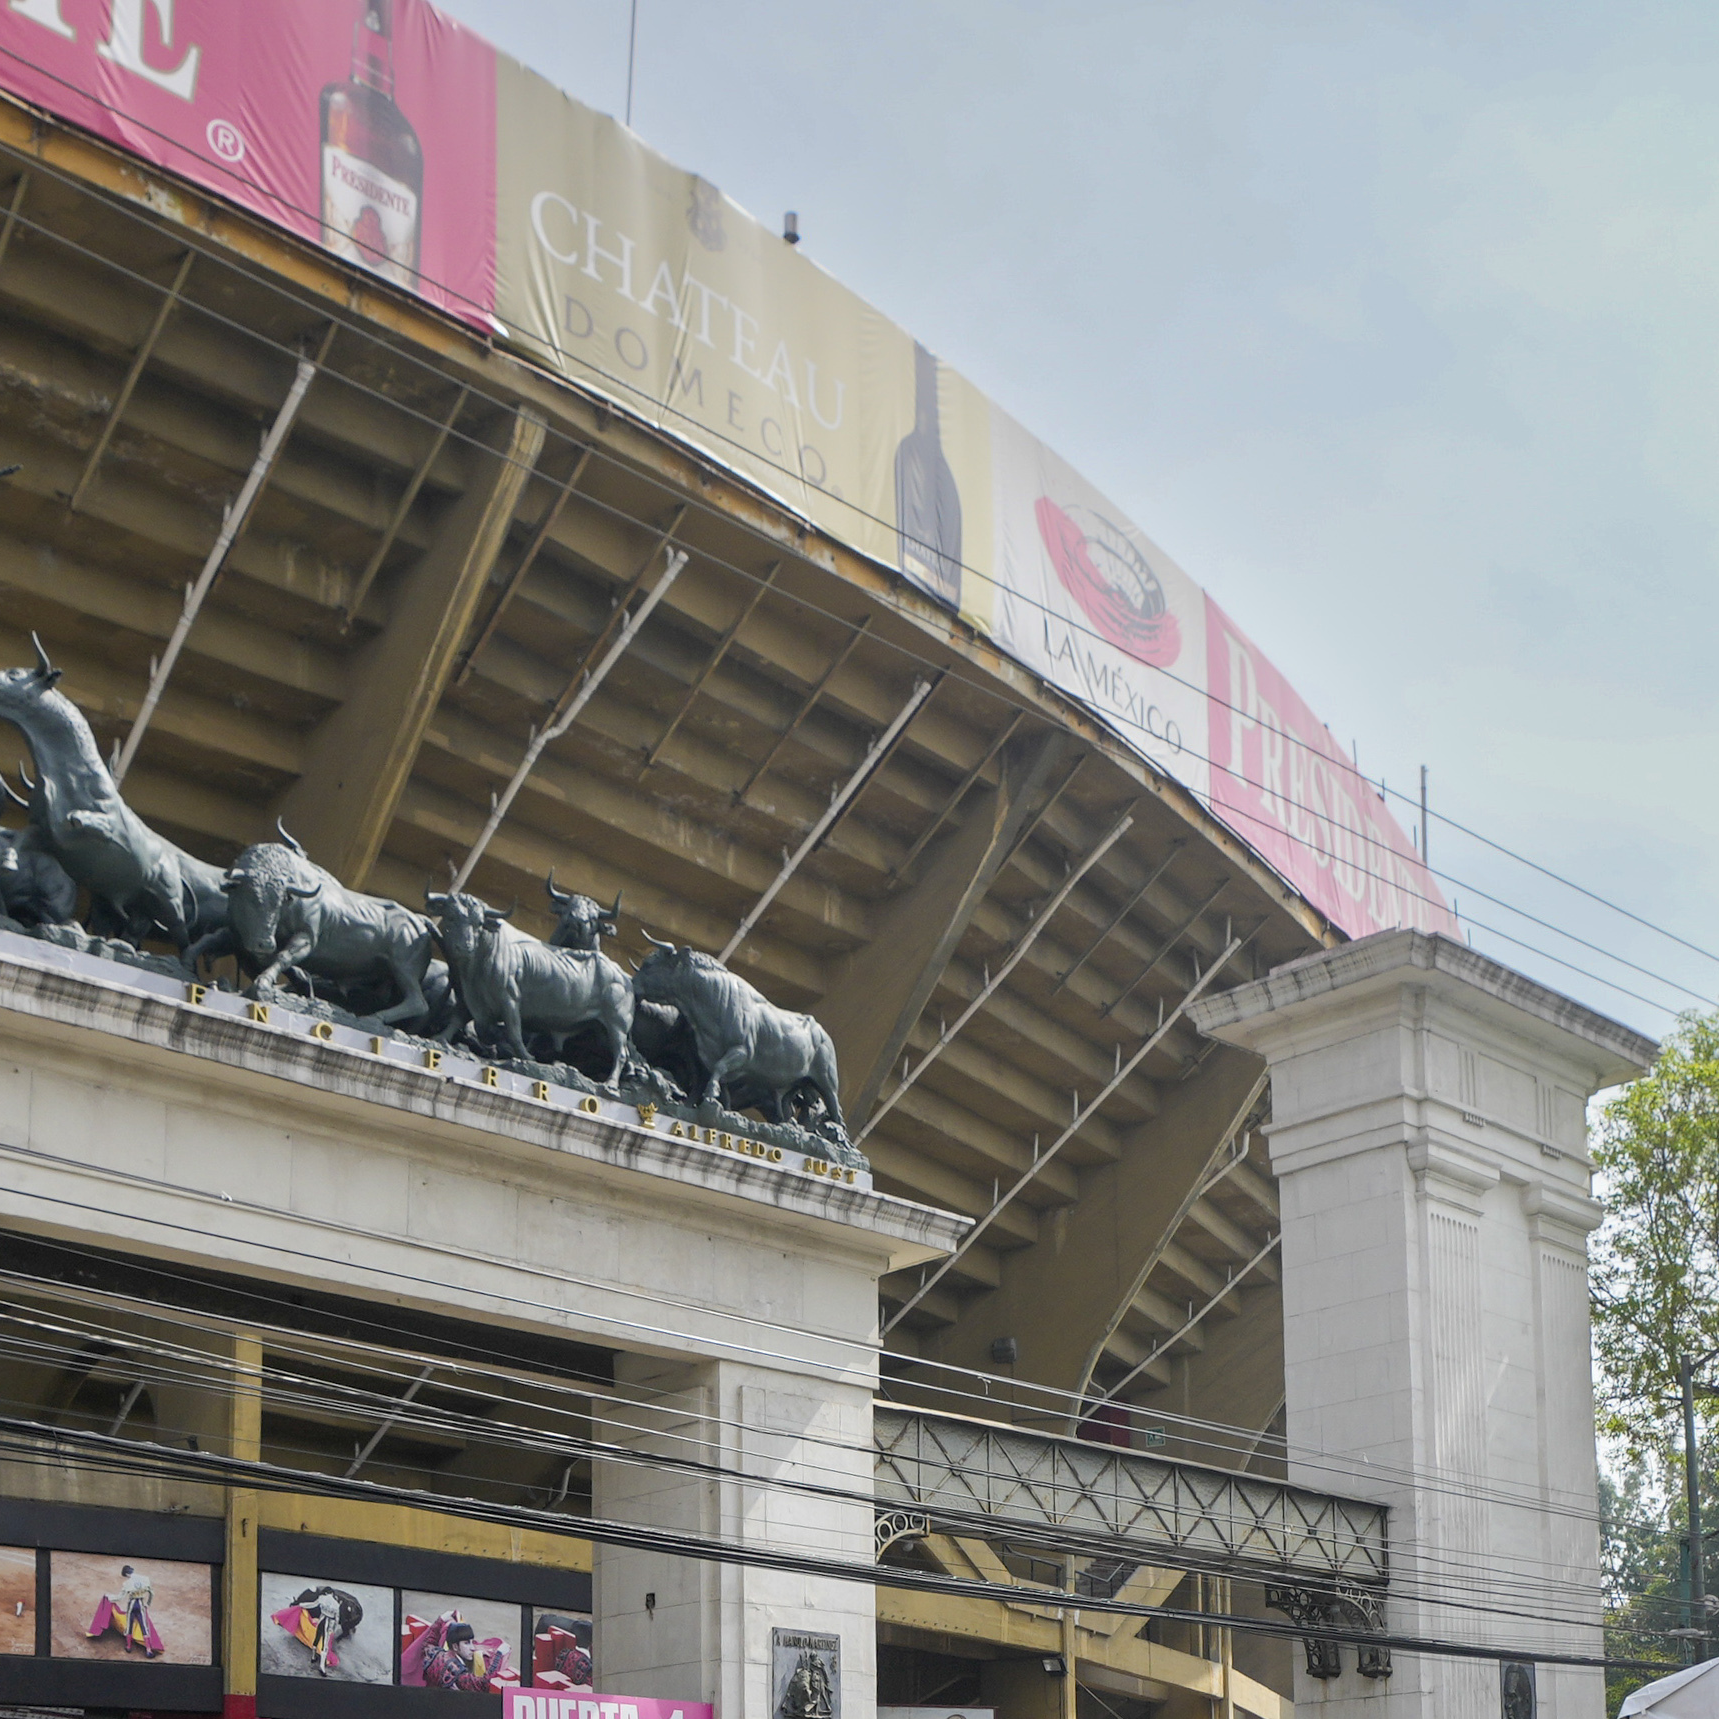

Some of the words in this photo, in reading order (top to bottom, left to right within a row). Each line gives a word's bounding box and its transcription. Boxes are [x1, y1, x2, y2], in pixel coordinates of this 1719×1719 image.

[331, 154, 410, 217] PRESIDENTE
[530, 190, 847, 431] CHATEAU
[564, 294, 827, 488] DOMECQ
[1044, 618, 1077, 671] LA
[1087, 651, 1181, 755] MÉXICO
[186, 983, 600, 1115] ENCIERRO
[670, 1121, 782, 1163] ALFREDO
[803, 1156, 858, 1184] JUST
